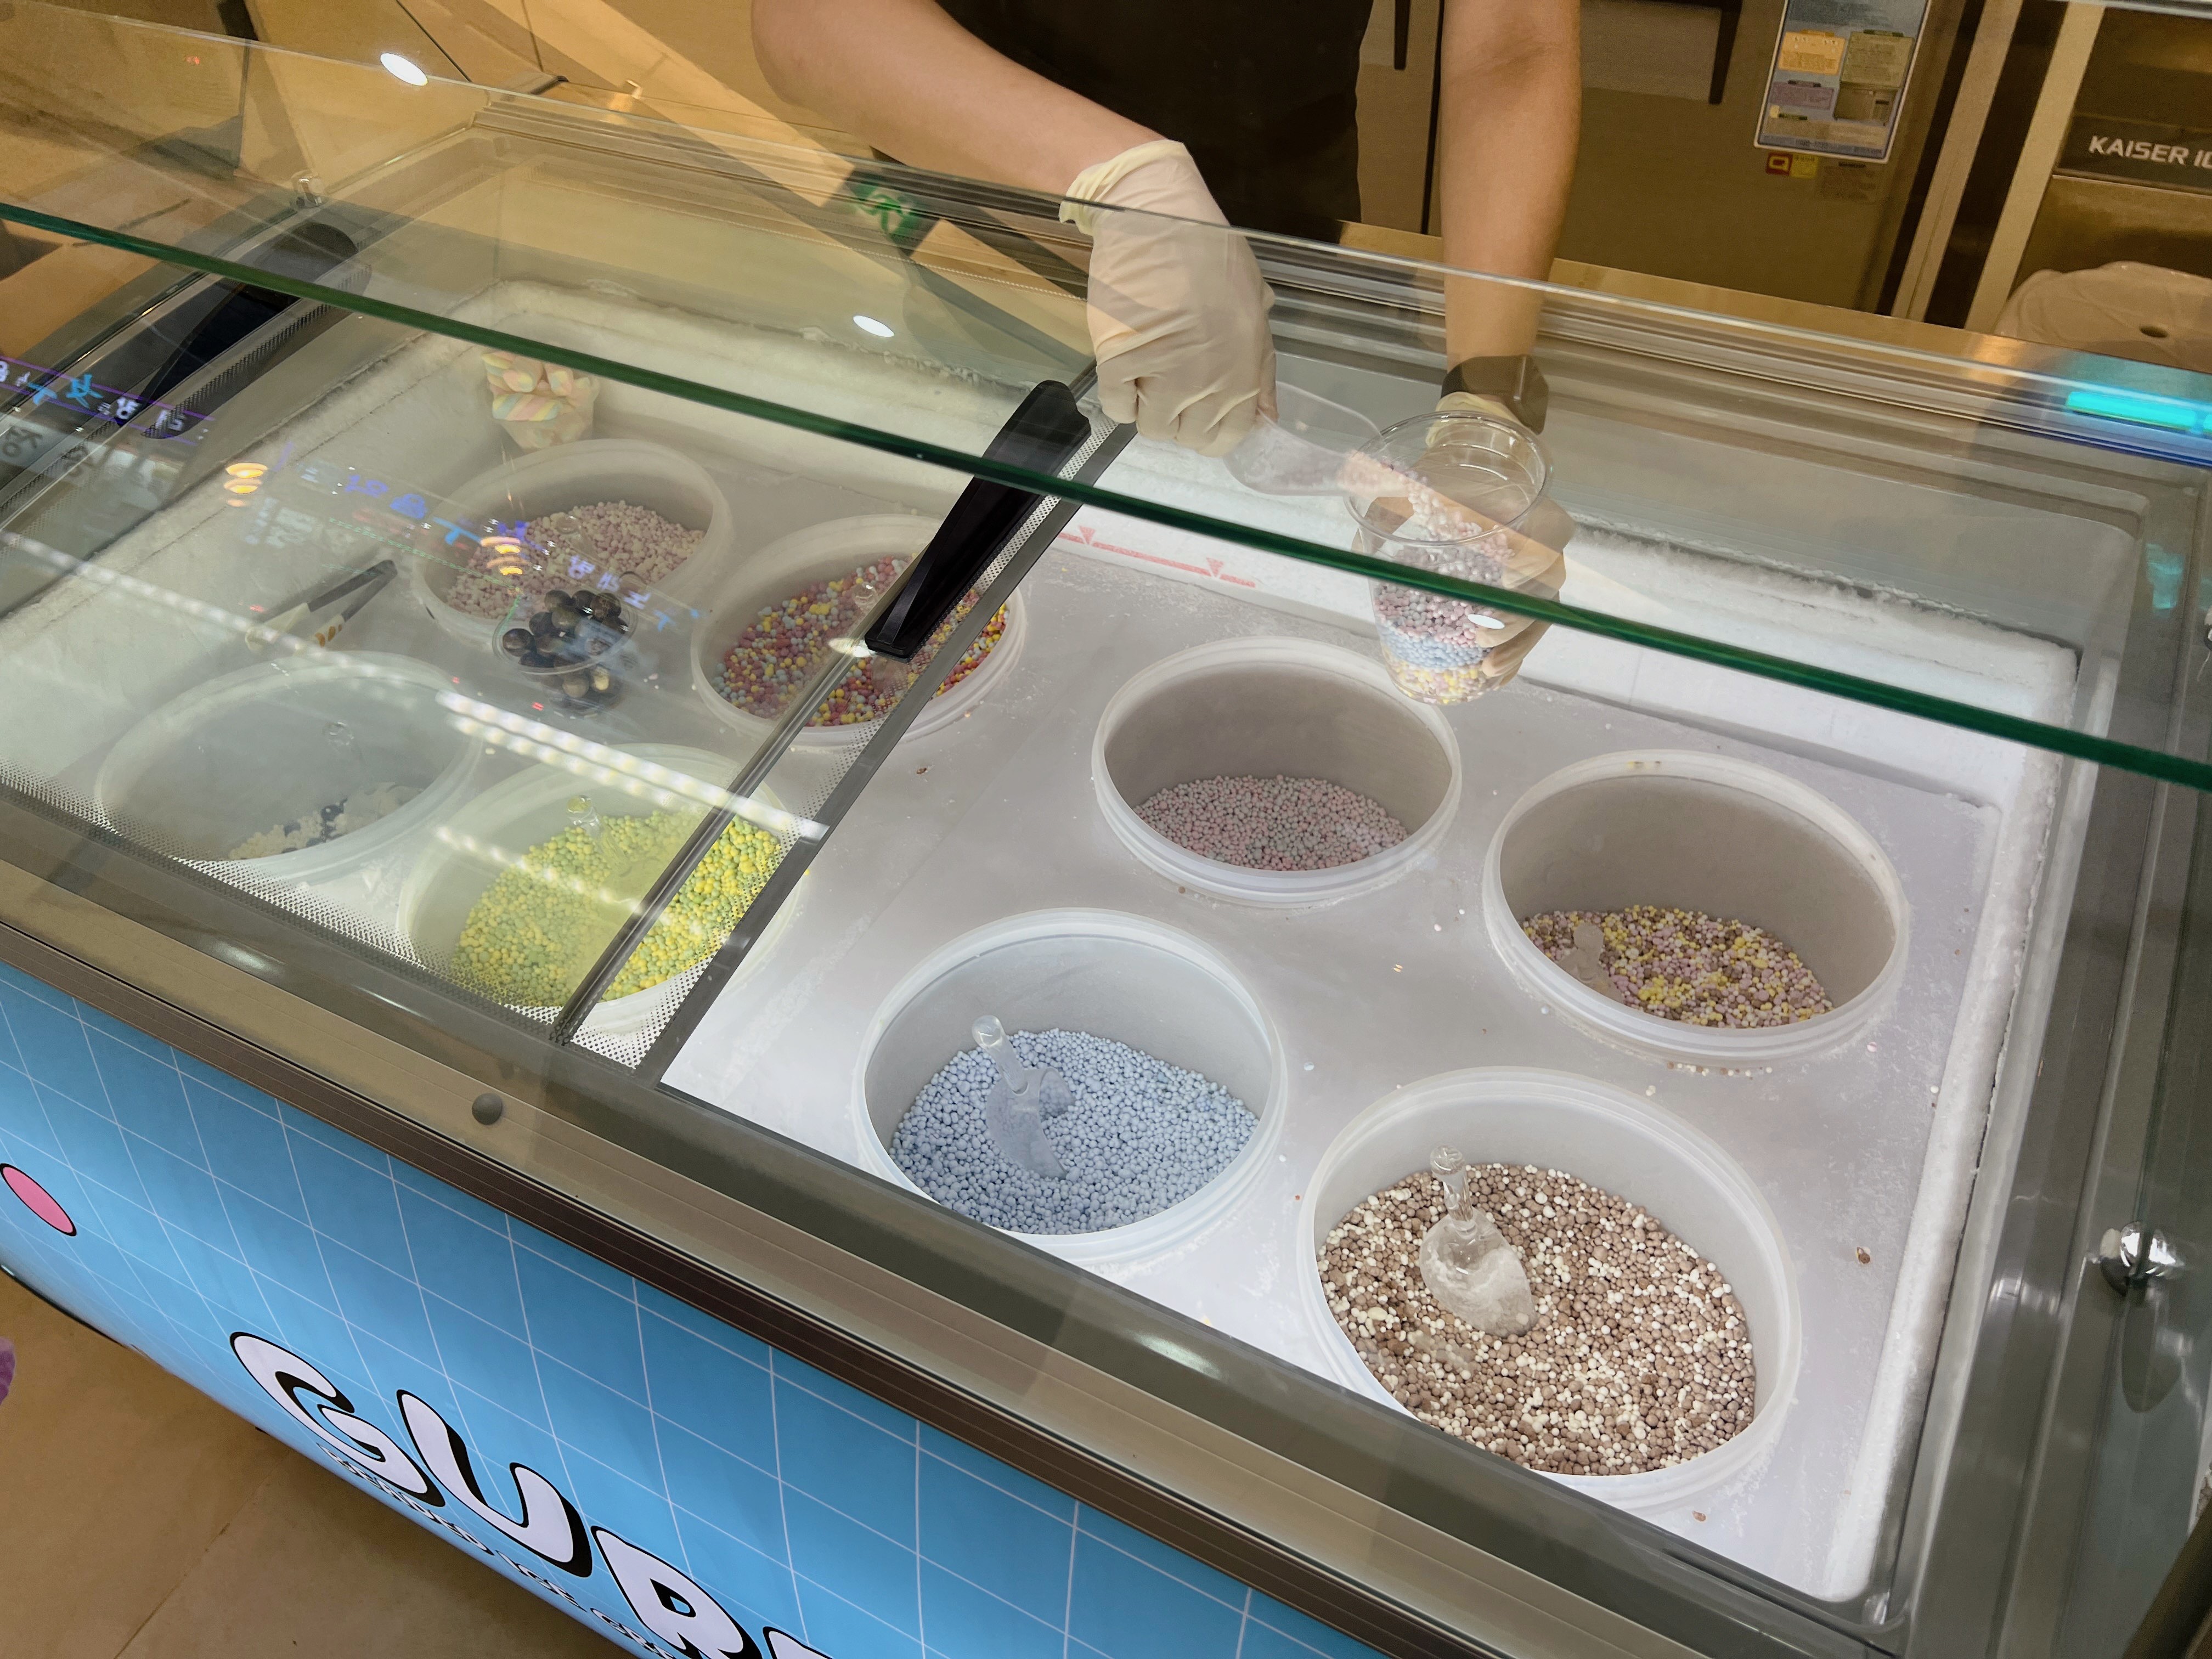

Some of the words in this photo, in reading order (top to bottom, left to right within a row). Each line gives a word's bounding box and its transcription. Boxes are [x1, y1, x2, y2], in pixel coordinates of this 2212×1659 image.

[2088, 135, 2190, 166] KAISER
[229, 1331, 833, 1659] GUR
[495, 1549, 588, 1613] ICE
